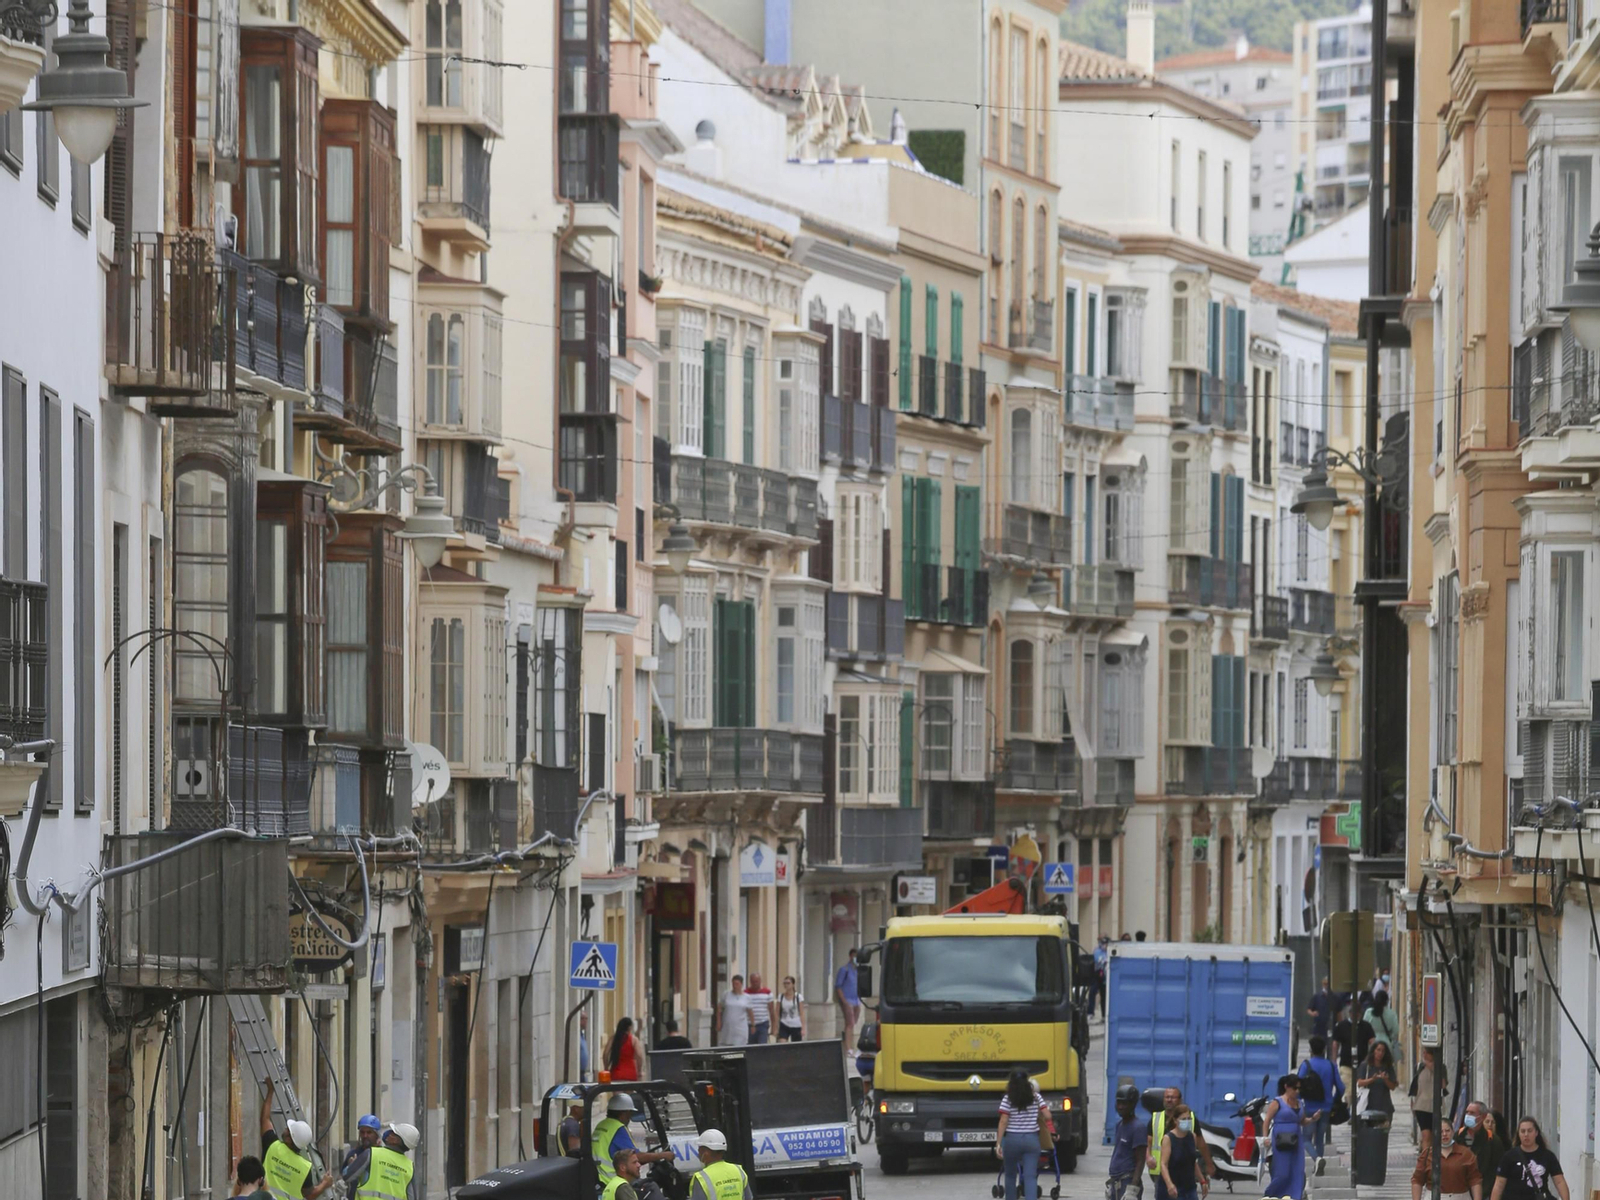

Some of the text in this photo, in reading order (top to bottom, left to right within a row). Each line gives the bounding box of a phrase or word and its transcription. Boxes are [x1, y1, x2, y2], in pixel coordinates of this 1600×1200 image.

[943, 1024, 1006, 1055] COMPRESORES
[783, 1130, 840, 1141] ANDAMIOS
[959, 1133, 978, 1141] 5982
[788, 1139, 841, 1150] 952 04 05 90
